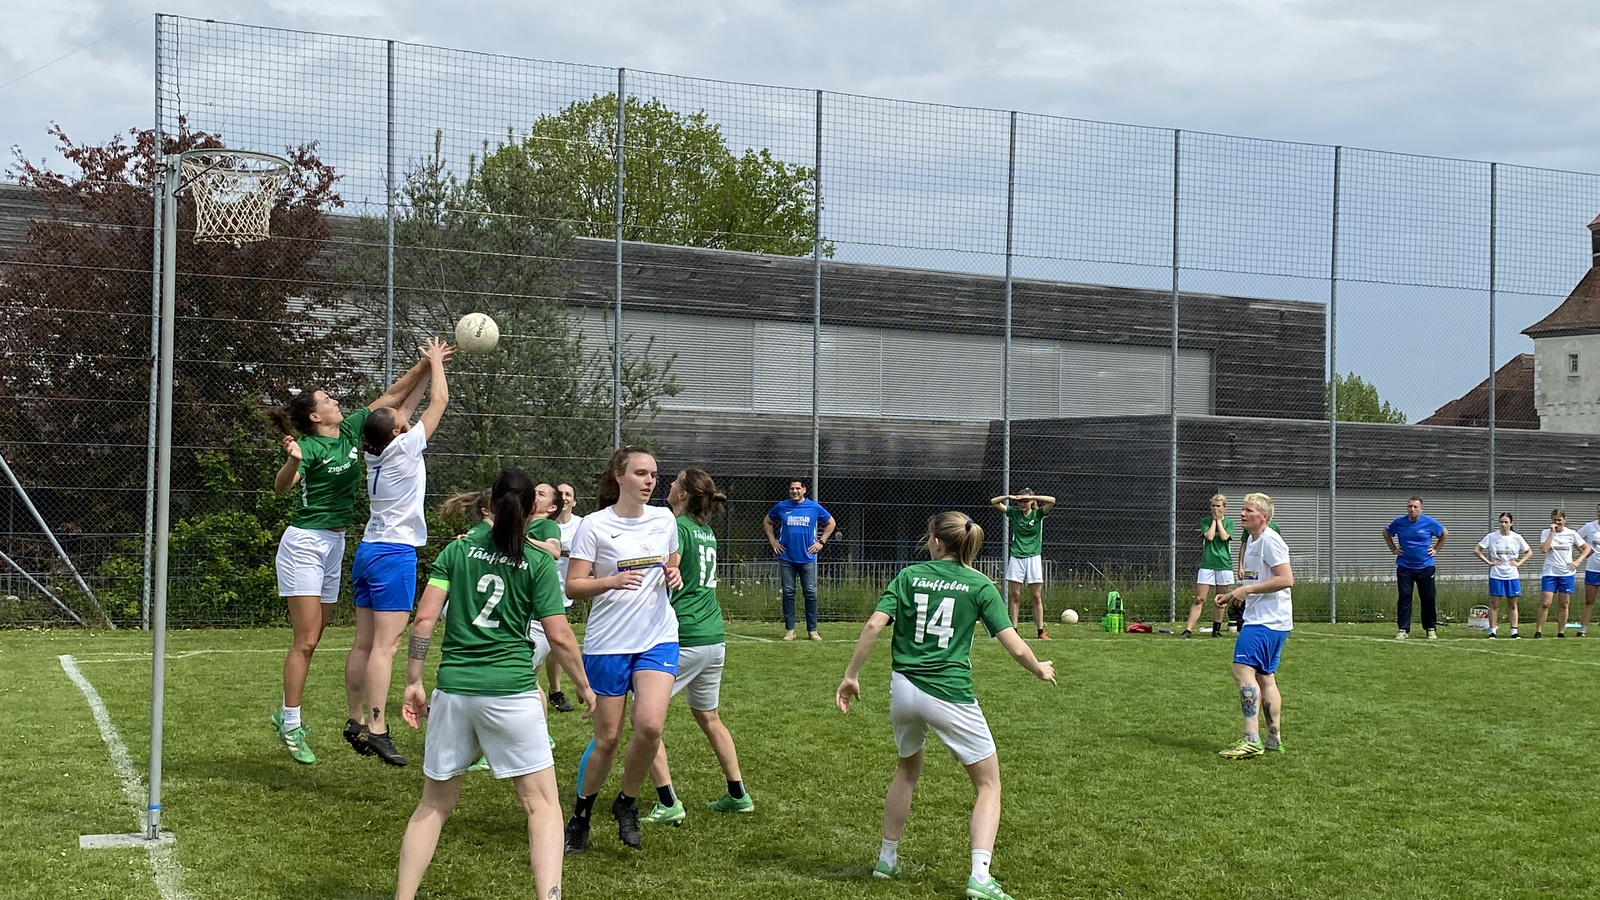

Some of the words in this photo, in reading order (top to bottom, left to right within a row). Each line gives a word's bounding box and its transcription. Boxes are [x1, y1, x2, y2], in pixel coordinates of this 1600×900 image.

[372, 465, 382, 495] 7
[699, 544, 717, 588] 12
[912, 577, 970, 592] Täuffelen
[472, 573, 505, 628] 2
[914, 593, 955, 648] 14
